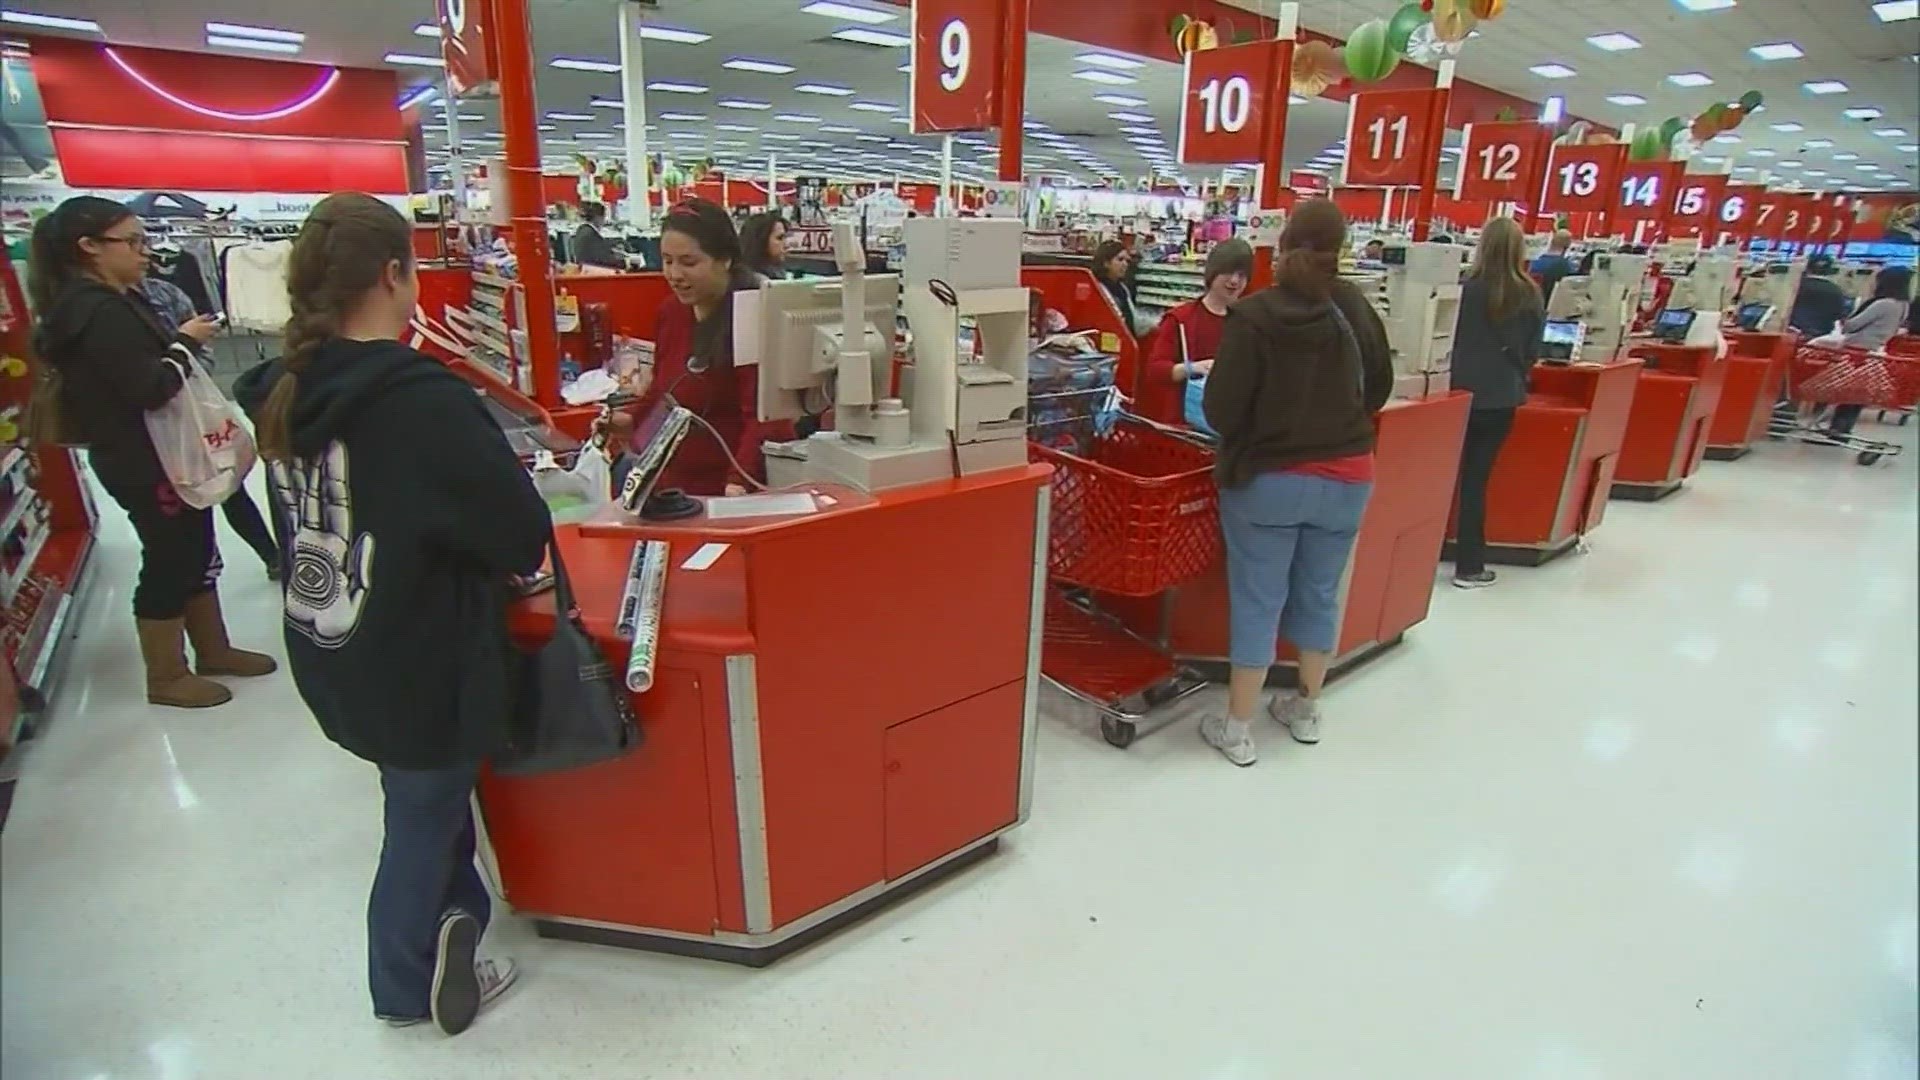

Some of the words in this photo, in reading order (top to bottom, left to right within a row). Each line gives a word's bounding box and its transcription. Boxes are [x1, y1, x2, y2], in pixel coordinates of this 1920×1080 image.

[940, 18, 970, 91] 9
[1200, 76, 1250, 133] 10
[1368, 115, 1408, 159] 11
[1480, 143, 1521, 181] 12
[1559, 161, 1600, 196] 13
[1621, 175, 1660, 206] 14
[1721, 196, 1744, 222] 6
[1757, 204, 1775, 226] 7
